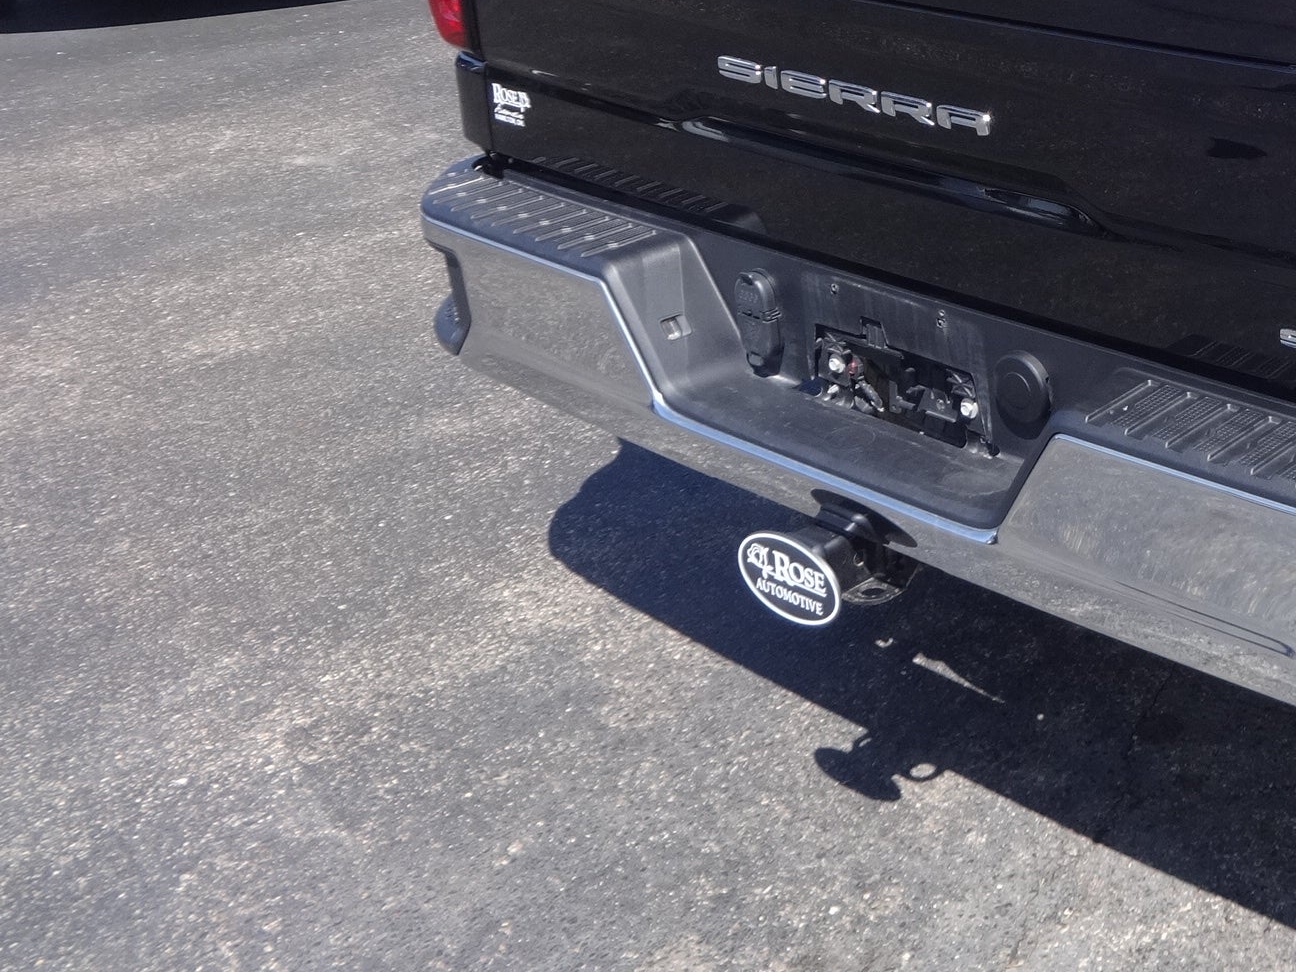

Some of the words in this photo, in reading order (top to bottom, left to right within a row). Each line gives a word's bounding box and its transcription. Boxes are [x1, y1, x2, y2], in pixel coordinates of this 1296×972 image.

[717, 55, 992, 137] SIERRA
[756, 577, 824, 616] AUTOMOTIVE
[772, 549, 828, 598] ROSE
